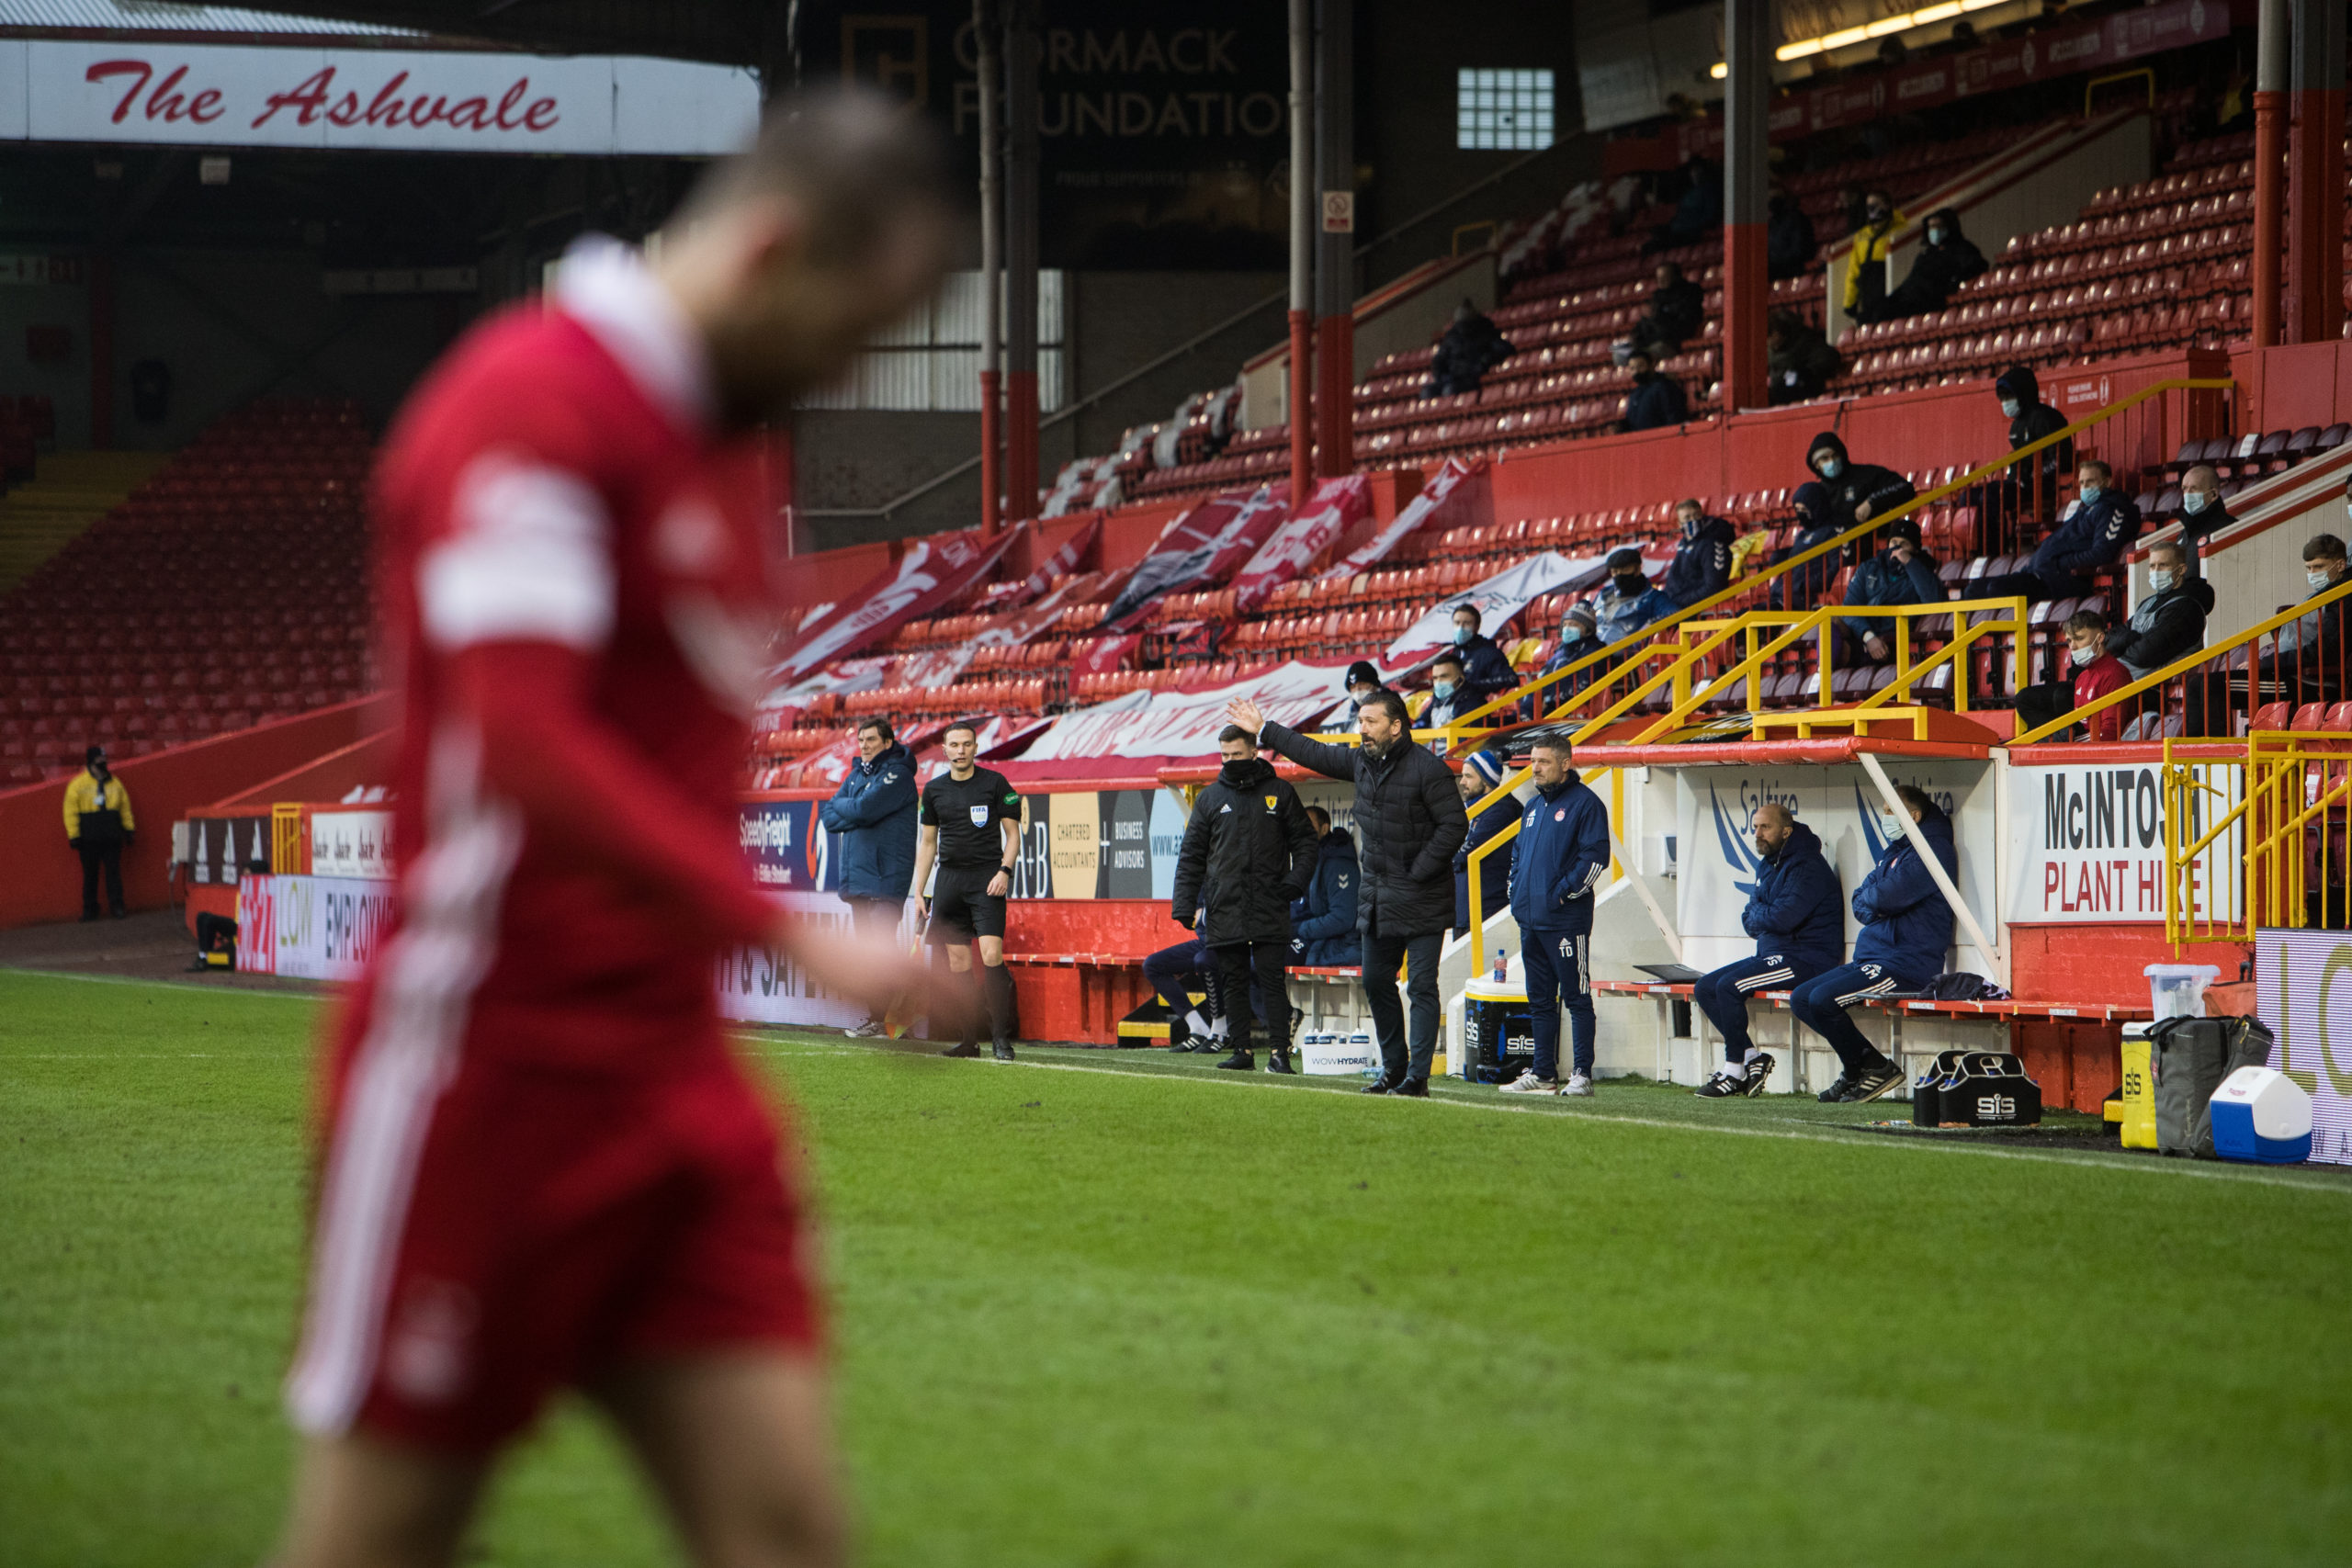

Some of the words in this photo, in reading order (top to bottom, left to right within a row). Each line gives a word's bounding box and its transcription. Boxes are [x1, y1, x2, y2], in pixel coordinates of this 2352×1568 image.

[954, 20, 1238, 73] CRMACK
[85, 59, 227, 126] The
[249, 65, 561, 134] Ashvale
[954, 83, 1290, 137] FUNDATIO
[1057, 823, 1091, 840] CHARTERED
[1114, 820, 1144, 840] BUSINESS
[1053, 852, 1095, 869] ACCOUNTANTS
[1114, 850, 1145, 869] ADVISORS
[2044, 860, 2129, 912] PLANT
[279, 879, 315, 946] LOW
[1292, 938, 1305, 950] PS
[1558, 945, 1574, 958] TD
[1860, 963, 1880, 980] GM
